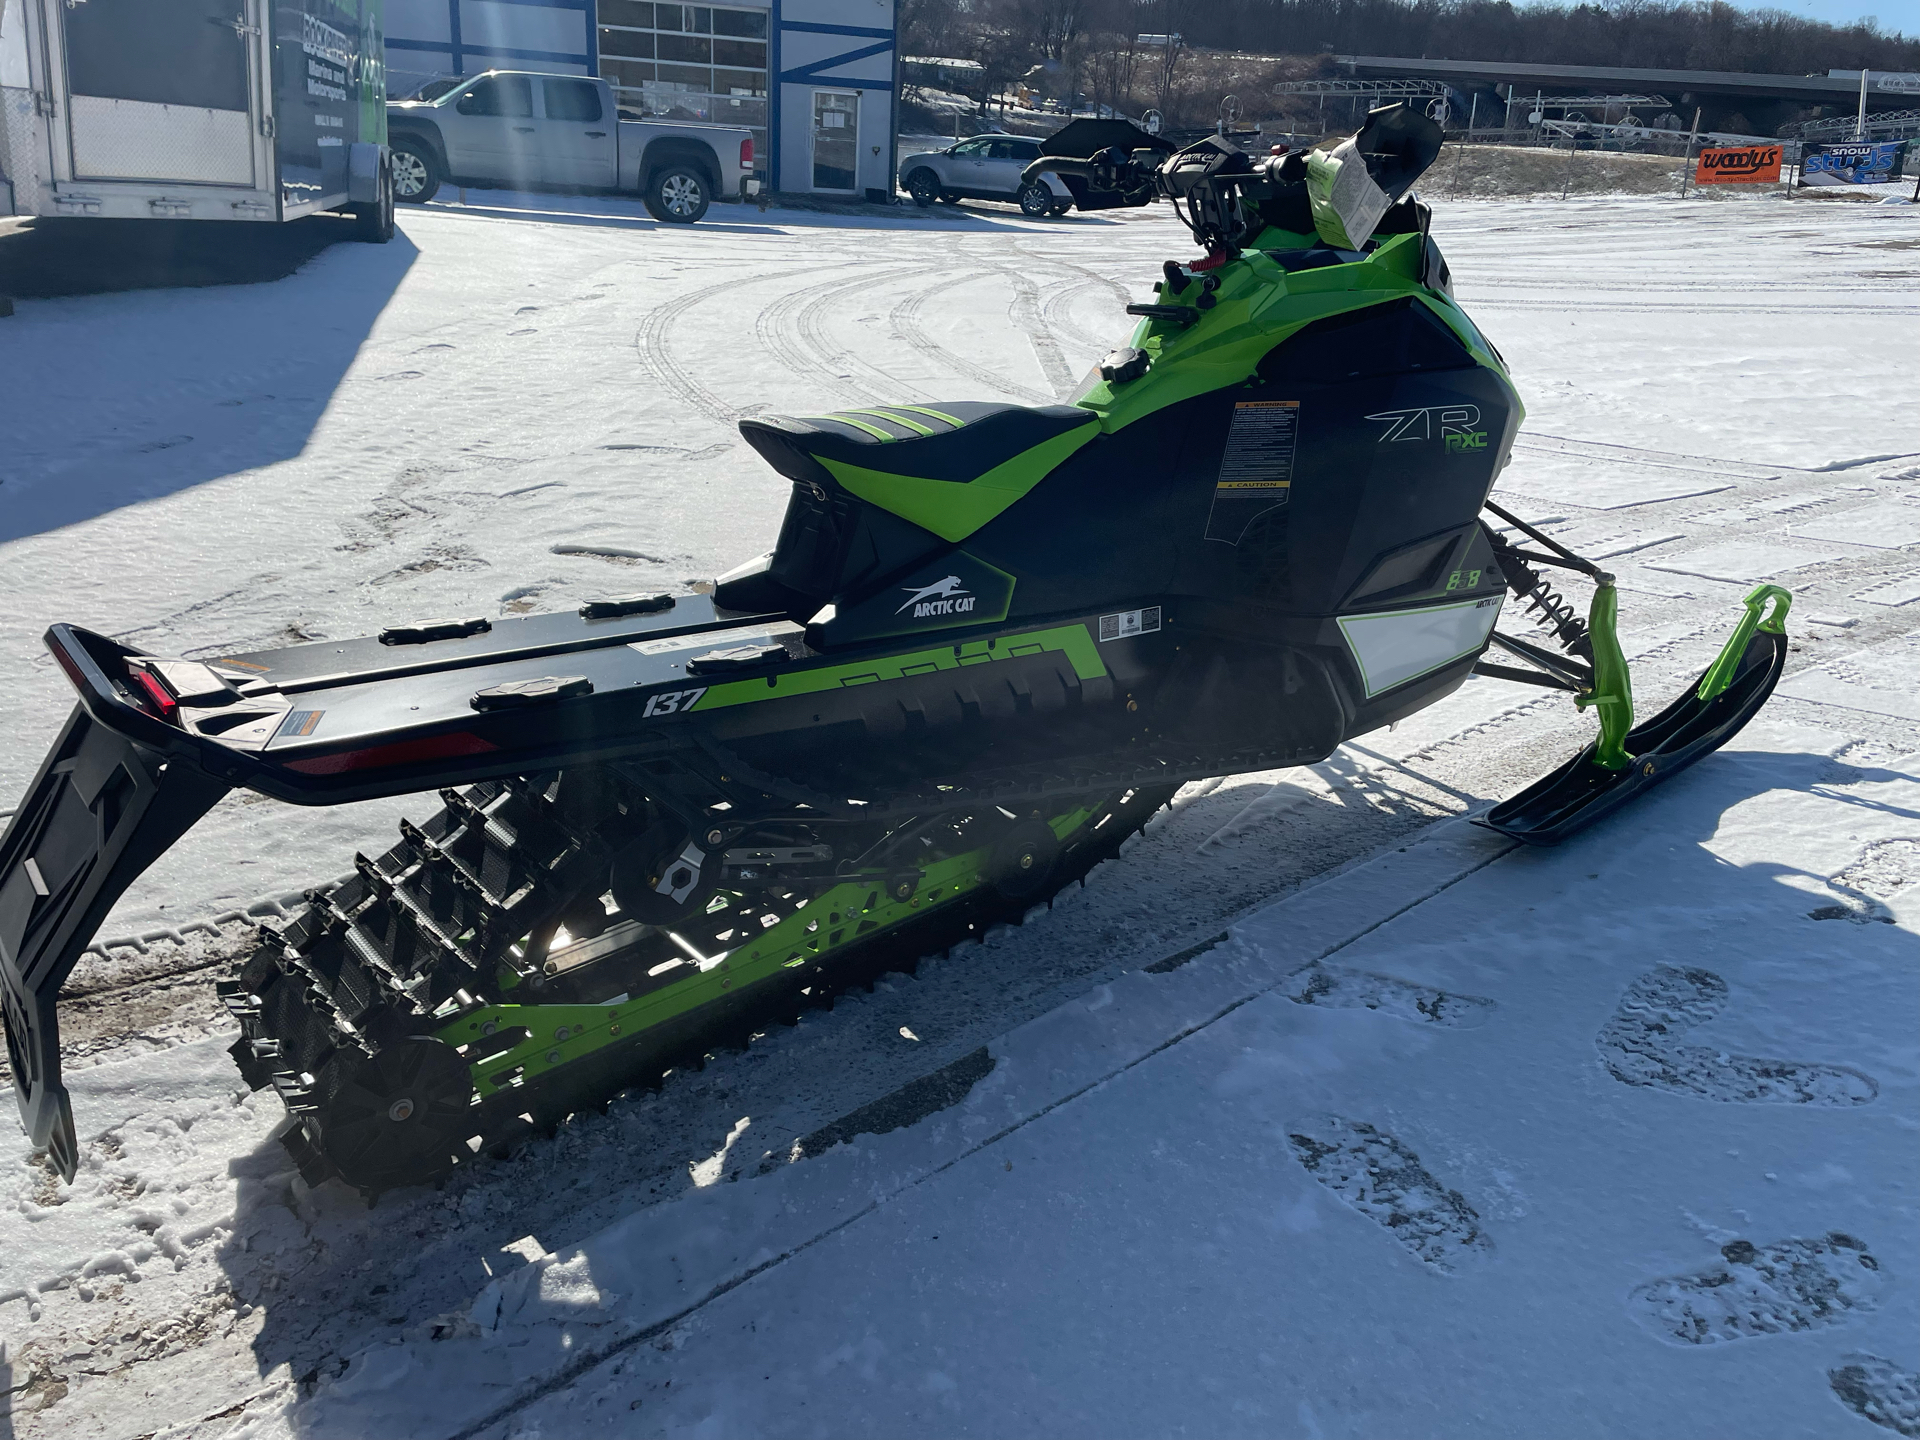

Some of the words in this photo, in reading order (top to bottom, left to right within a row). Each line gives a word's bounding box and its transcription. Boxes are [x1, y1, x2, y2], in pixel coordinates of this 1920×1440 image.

[1363, 404, 1480, 442] ZR
[913, 600, 954, 618] ARCTIC
[954, 597, 976, 613] CAT
[1475, 599, 1491, 609] ARCTIC
[641, 686, 708, 719] 137
